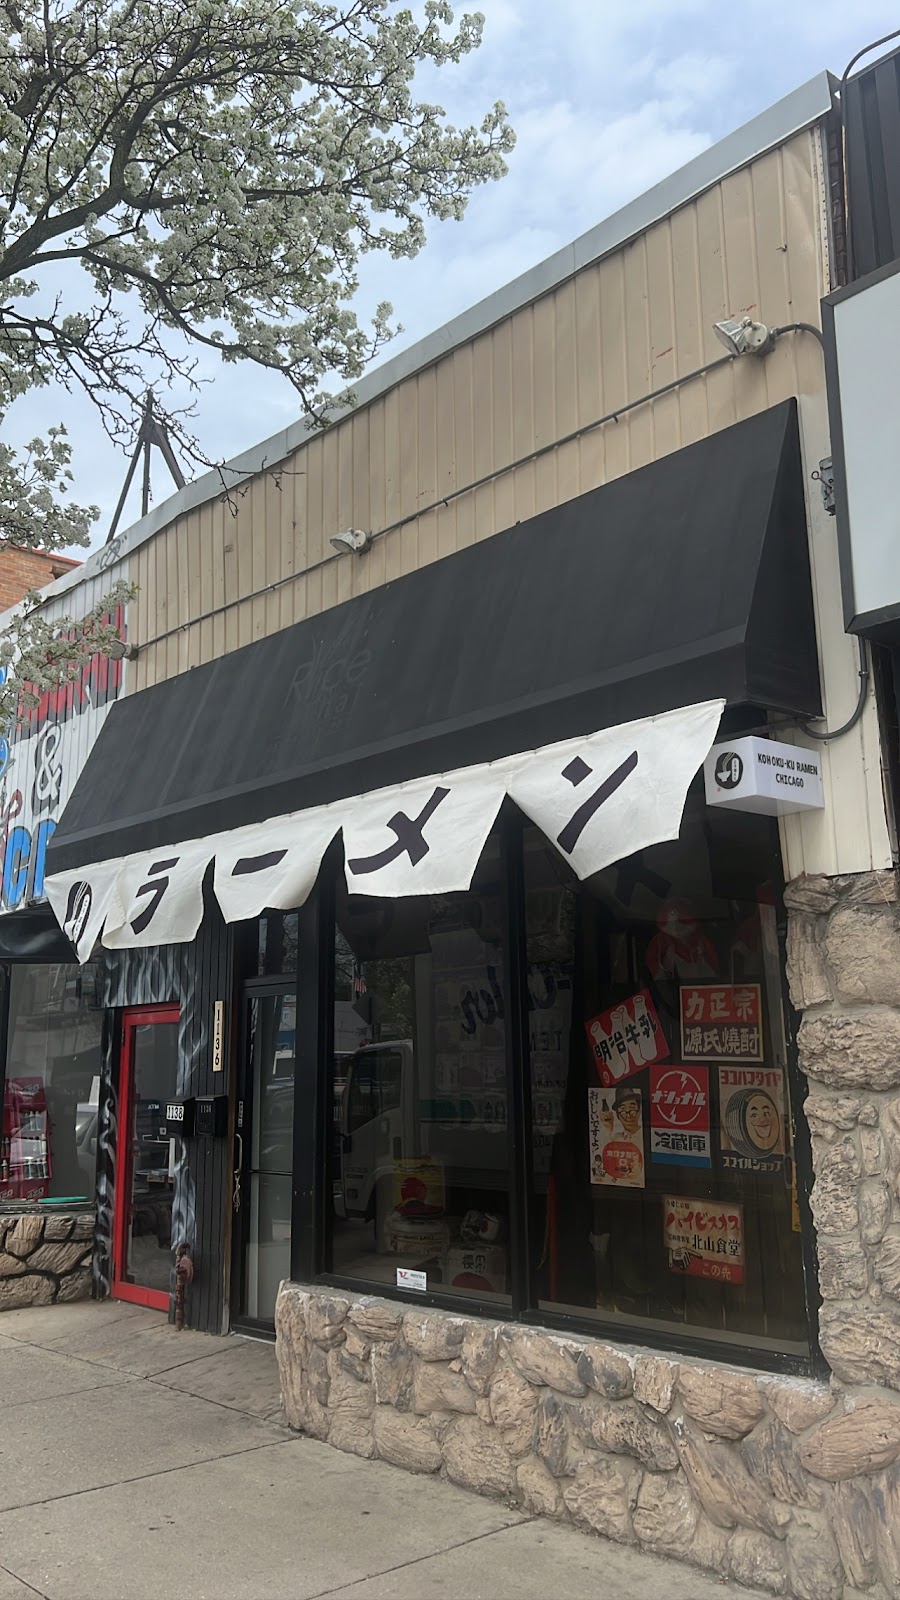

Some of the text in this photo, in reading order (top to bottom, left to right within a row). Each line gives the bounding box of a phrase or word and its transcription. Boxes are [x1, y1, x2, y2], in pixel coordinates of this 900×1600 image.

[757, 753, 818, 776] KOHOKU-KU RAMEN
[775, 772, 804, 788] CHICAGO
[129, 750, 638, 935] ラーメン
[685, 988, 756, 1022] 力正宗
[214, 1008, 222, 1066] 1136
[593, 1012, 658, 1063] 明治牛乳
[720, 1069, 782, 1087] ヨコハマタイヤ
[147, 1103, 160, 1111] ATM
[651, 1089, 706, 1106] ナショナル
[168, 1106, 183, 1119] 1138
[654, 1131, 706, 1152] 冷蔵庫
[666, 1211, 740, 1231] ハイビスカス
[691, 1234, 740, 1257] 北山食堂
[702, 1263, 732, 1281] この先
